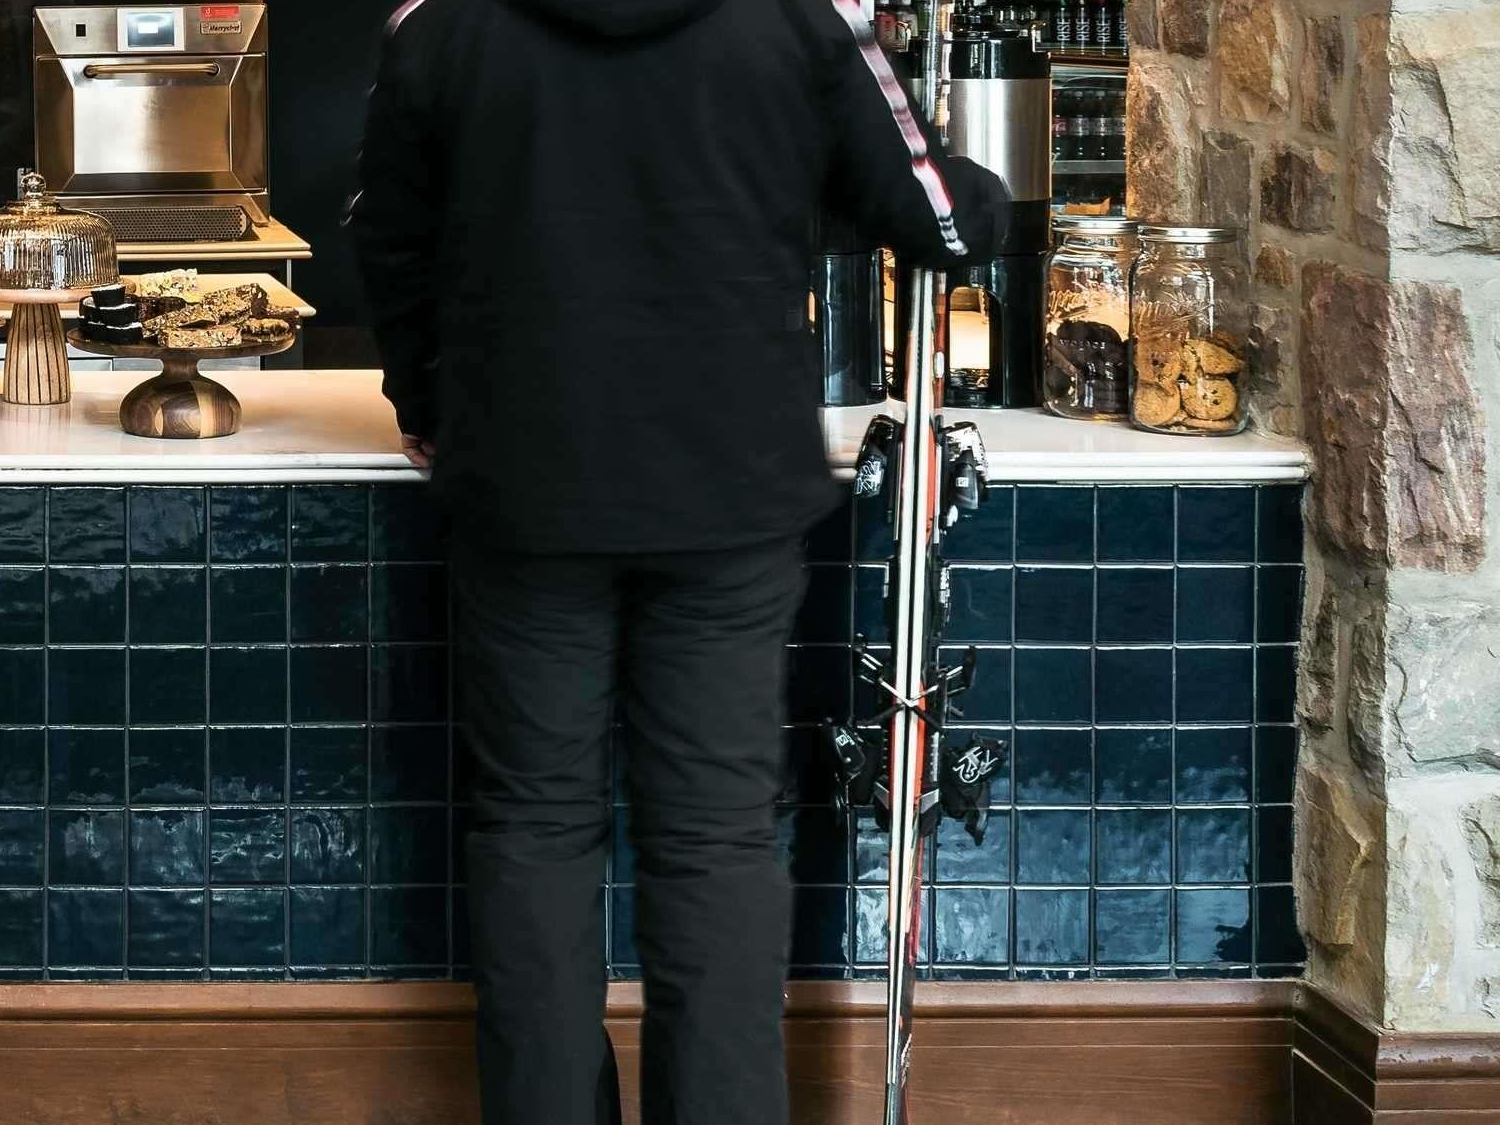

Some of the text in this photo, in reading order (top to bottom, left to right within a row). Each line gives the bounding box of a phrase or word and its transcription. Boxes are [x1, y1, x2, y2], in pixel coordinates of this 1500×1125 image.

[1057, 19, 1071, 41] RISE
[1076, 19, 1090, 41] RISE
[1097, 20, 1110, 42] RISE
